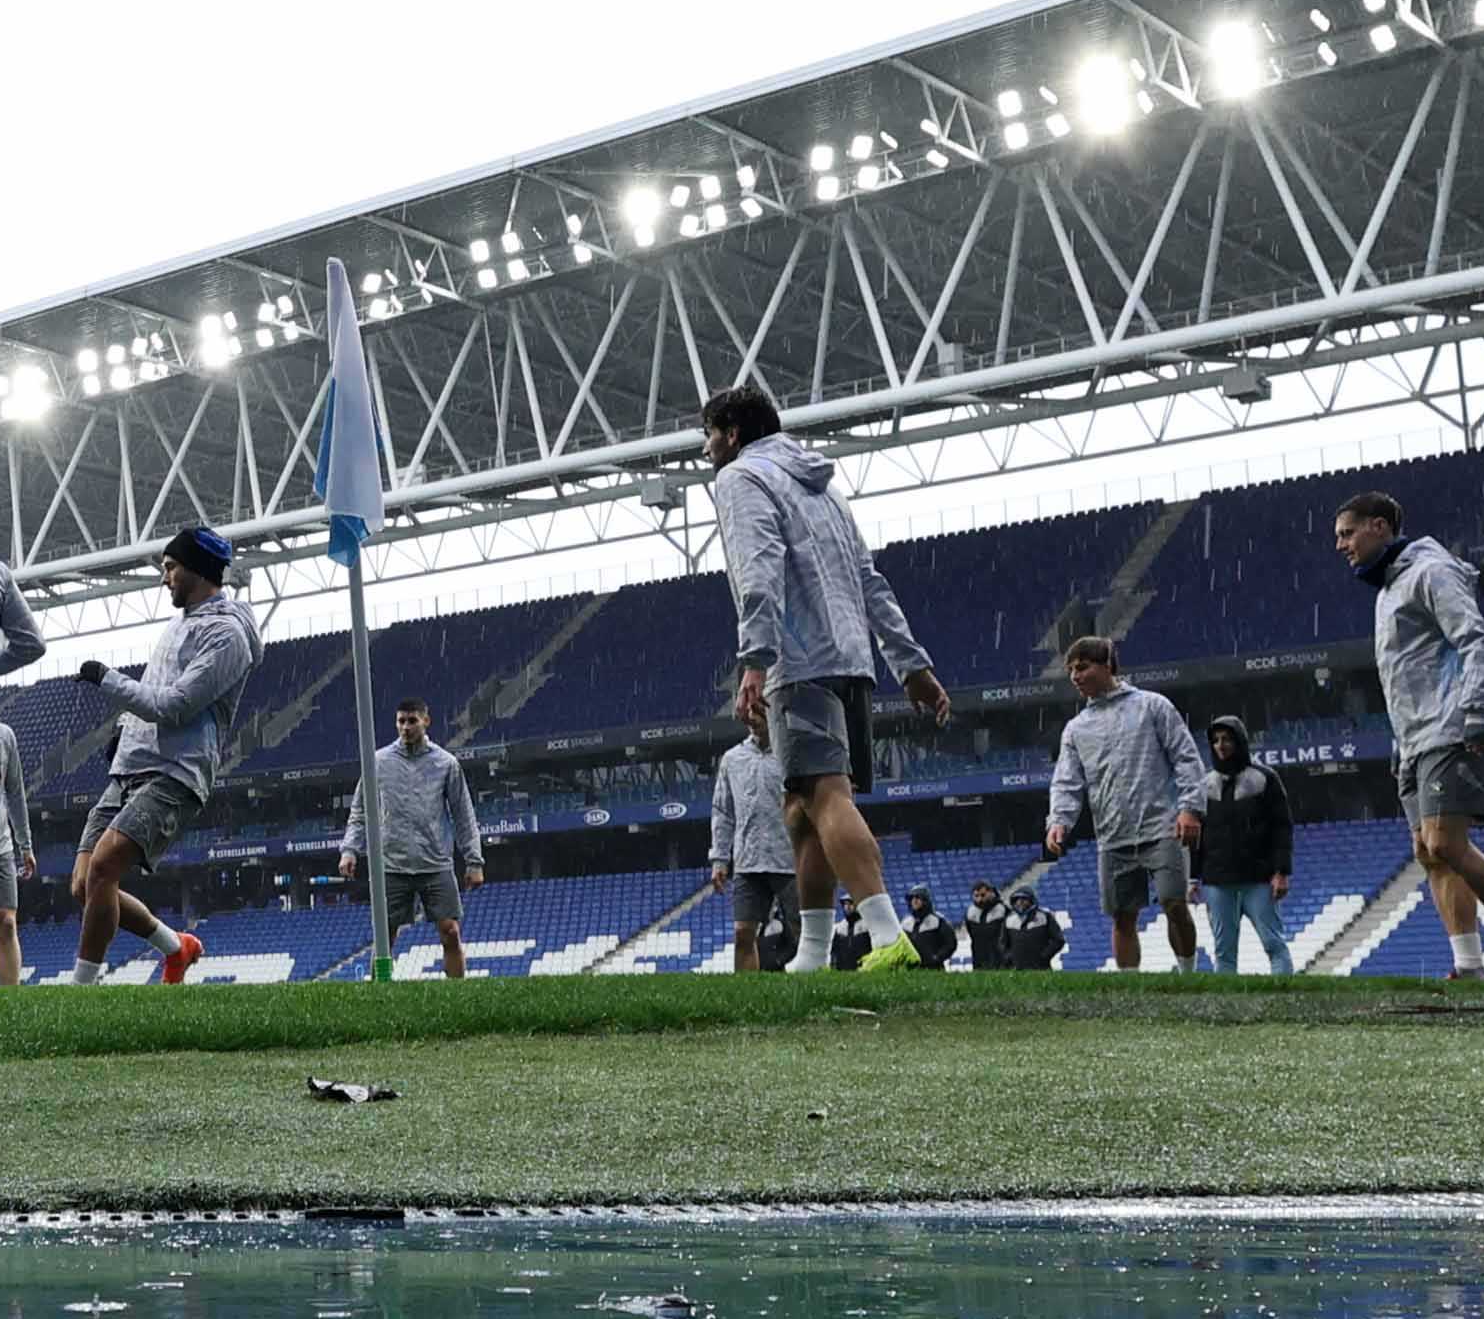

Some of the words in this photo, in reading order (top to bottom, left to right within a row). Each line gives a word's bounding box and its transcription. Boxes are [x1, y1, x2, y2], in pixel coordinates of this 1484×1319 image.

[1245, 657, 1277, 670] RCDE
[1280, 651, 1328, 667] STADIUM
[983, 689, 1009, 700] RCDE
[640, 729, 664, 739] RCDE
[547, 738, 569, 750] RCDE
[1249, 745, 1333, 766] KELME
[888, 784, 911, 796] RCDE
[216, 848, 247, 858] ESTRELLA
